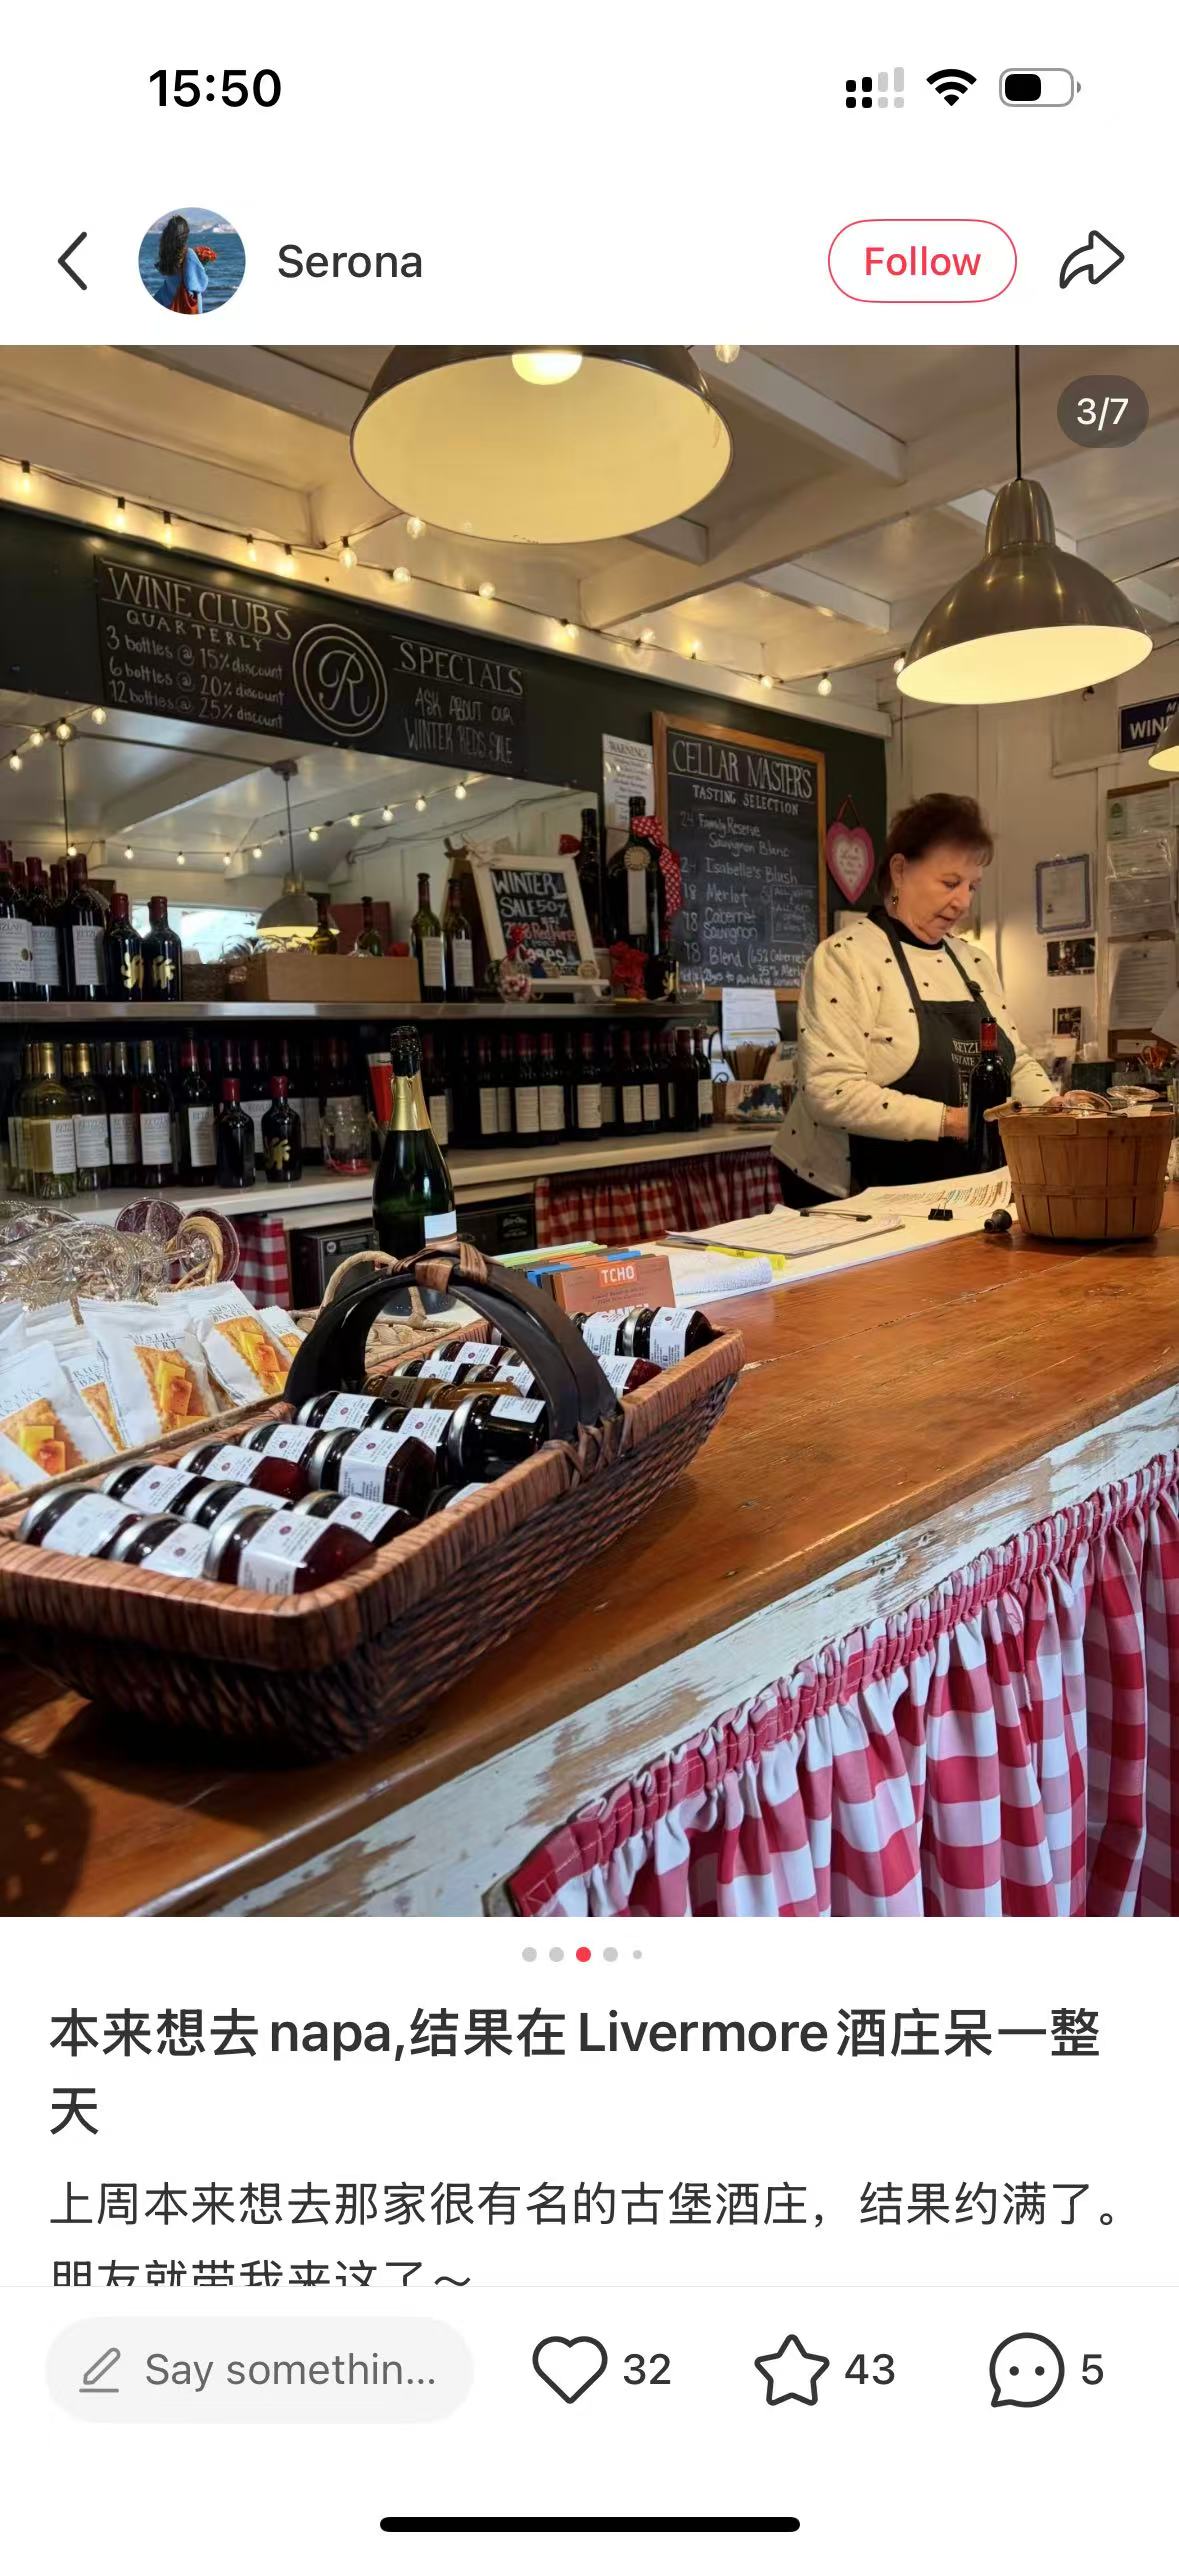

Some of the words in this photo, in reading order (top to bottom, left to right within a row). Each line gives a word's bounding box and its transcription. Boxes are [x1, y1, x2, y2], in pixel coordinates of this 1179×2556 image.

[108, 567, 193, 617] WINE
[199, 591, 291, 640] CLUBS
[127, 609, 263, 651] QUARTERLY
[106, 625, 120, 650] 3
[125, 634, 173, 659] bottles
[199, 647, 231, 671] 15%
[232, 656, 283, 681] discount
[400, 641, 524, 697] SPECIALS
[109, 656, 122, 677] 6
[125, 663, 173, 687] bottles
[200, 674, 233, 697] 20%
[235, 685, 284, 706] discount
[319, 650, 371, 717] R
[109, 680, 128, 704] 12
[129, 688, 175, 711] bottles
[198, 697, 233, 720] 25%
[236, 709, 283, 729] discount
[415, 687, 442, 718] ASK
[449, 695, 483, 722] ABOUT
[491, 705, 514, 725] OUR
[404, 717, 453, 751] WINTER
[457, 725, 487, 758] REDS
[489, 731, 514, 764] SALE
[672, 740, 740, 783] CELLAR
[692, 784, 737, 805] TASTING
[743, 793, 799, 816] SELECTION
[491, 870, 557, 898] WINTER
[705, 882, 749, 908] Merlot
[765, 865, 798, 885] Blush
[500, 896, 539, 918] SALE
[709, 946, 745, 967] Blend
[601, 1265, 634, 1284] TCHO
